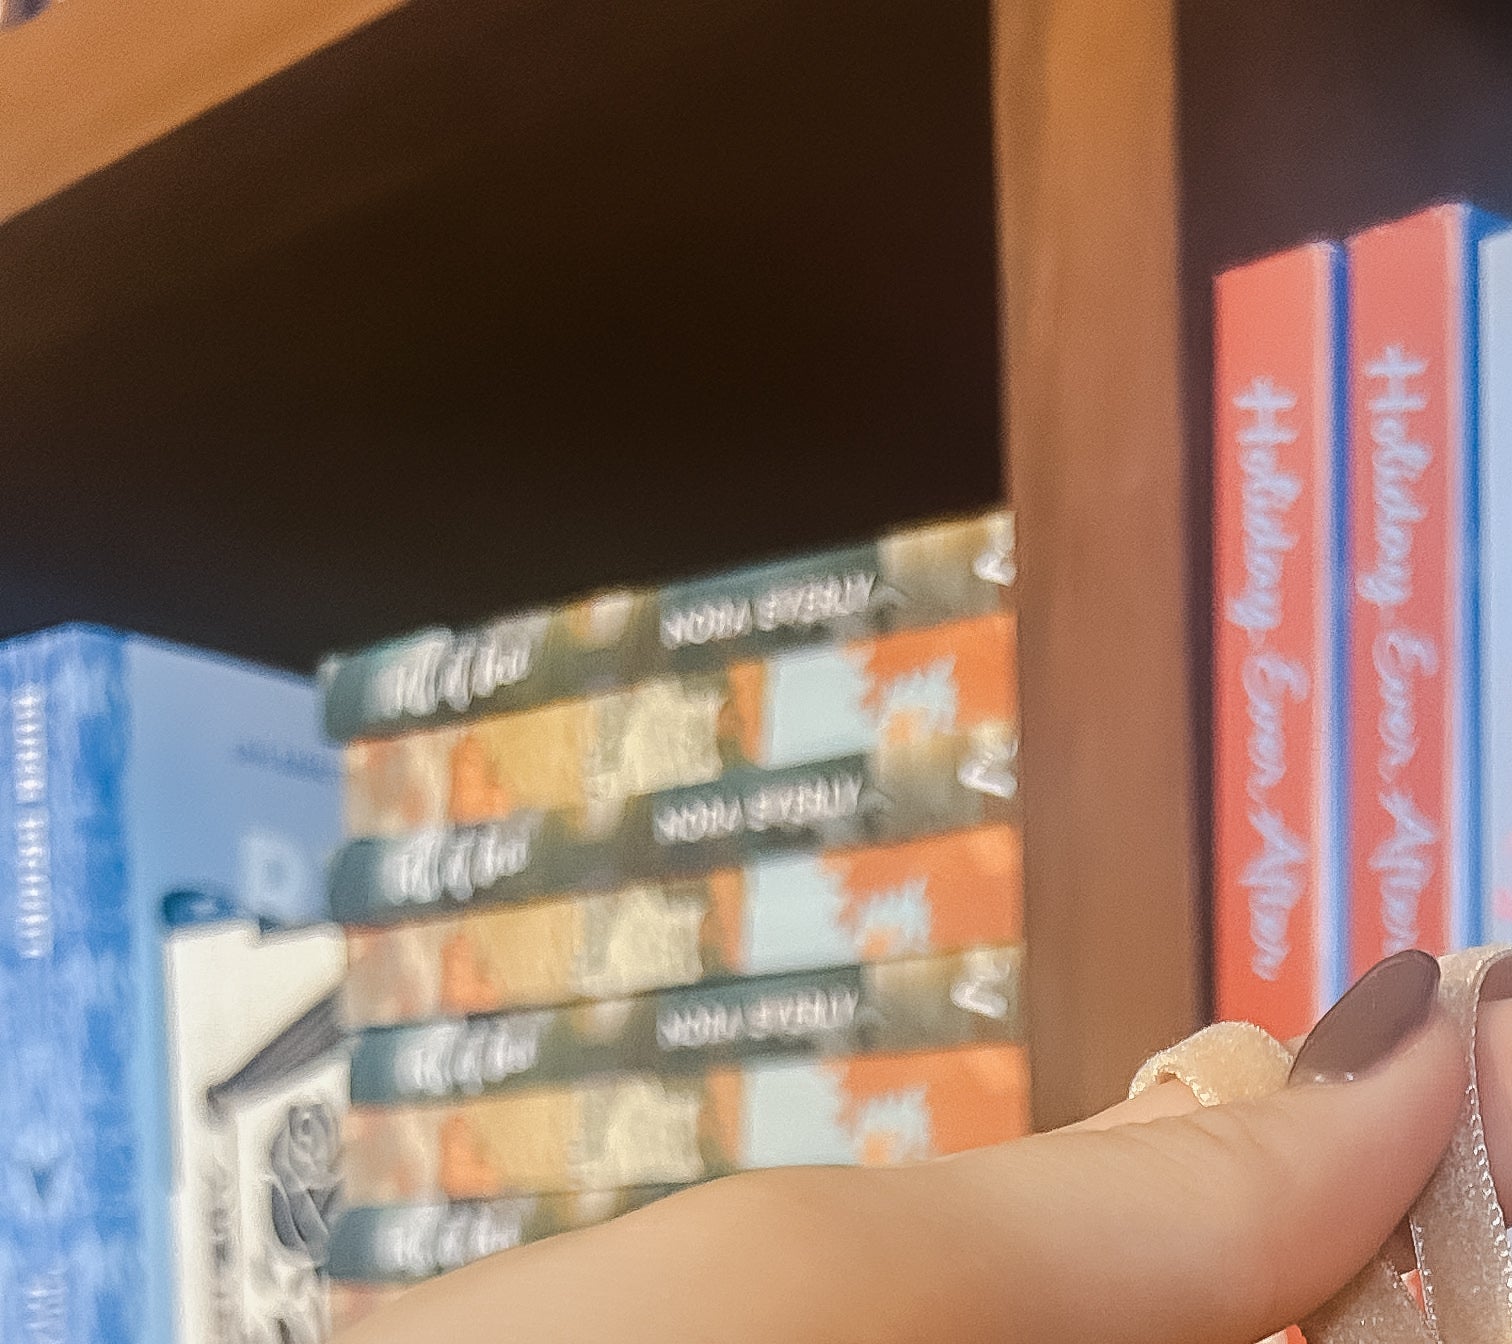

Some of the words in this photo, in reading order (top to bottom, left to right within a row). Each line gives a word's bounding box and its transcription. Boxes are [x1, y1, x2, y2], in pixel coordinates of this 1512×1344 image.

[1229, 376, 1301, 640] Holiday
[1359, 343, 1433, 607] Holiday
[1243, 648, 1309, 802] Ever
[1375, 628, 1440, 779] Ever
[1241, 804, 1308, 980] After
